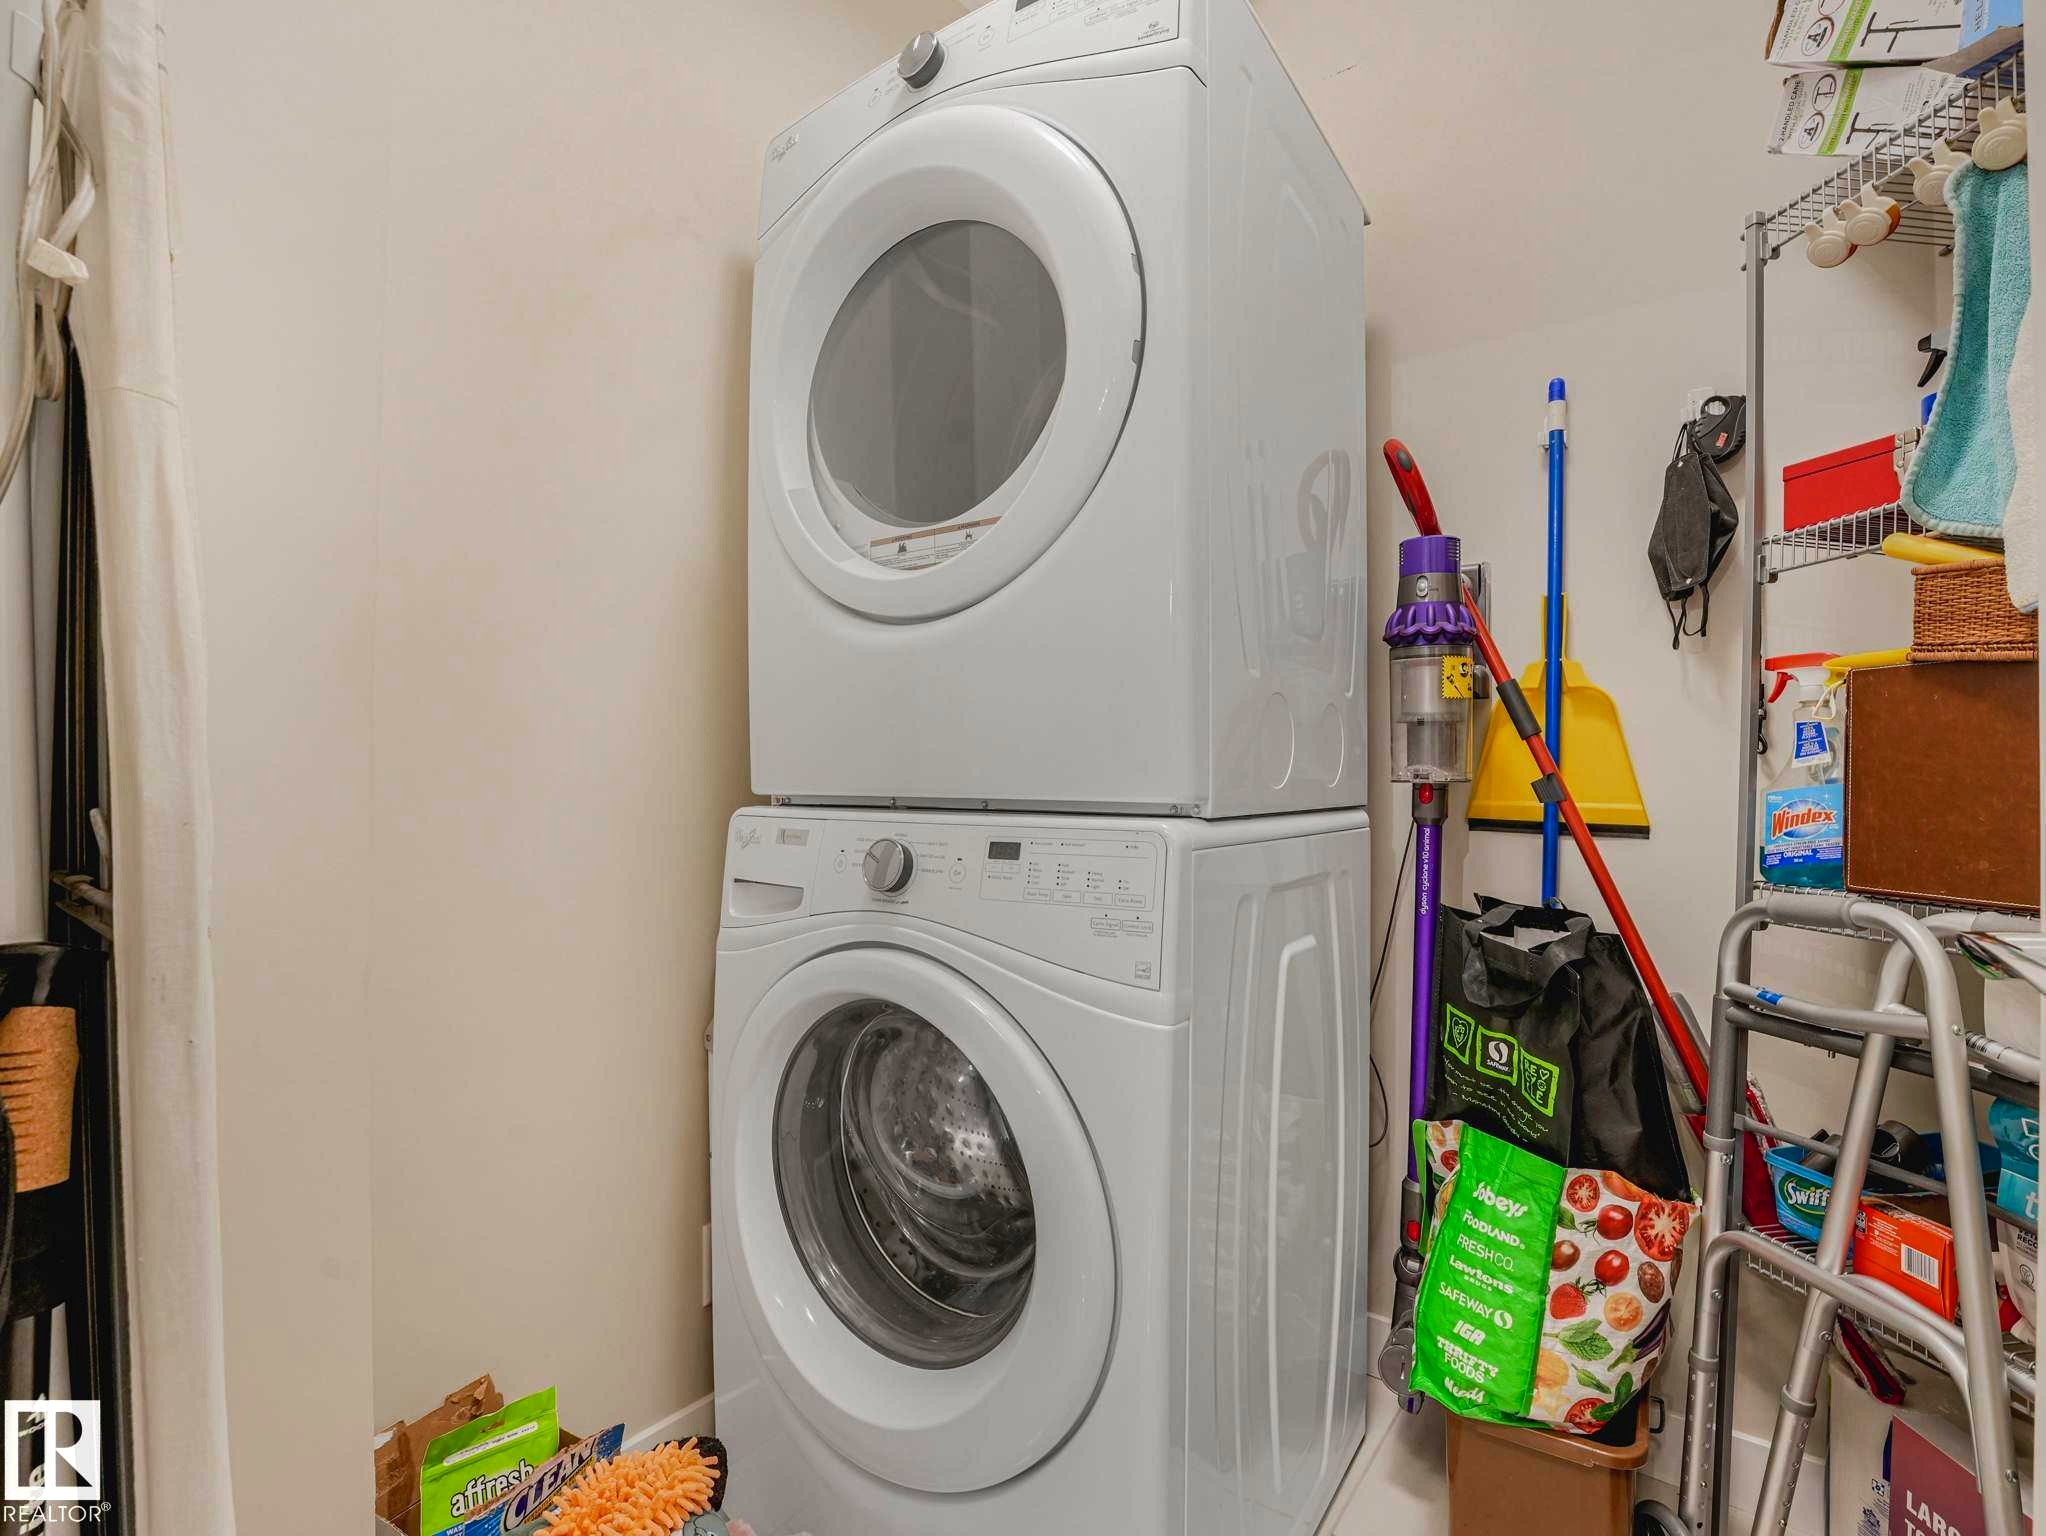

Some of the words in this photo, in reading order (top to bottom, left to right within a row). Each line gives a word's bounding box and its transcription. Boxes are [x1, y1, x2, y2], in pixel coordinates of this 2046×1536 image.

[1791, 79, 1801, 100] CANE
[1772, 807, 1835, 839] Windex
[1423, 827, 1431, 851] animal
[1783, 849, 1813, 858] ORIGINAL
[1421, 864, 1430, 890] cyclone
[1419, 892, 1429, 915] dyson
[1788, 1182, 1831, 1206] Swiff
[1463, 1211, 1521, 1247] FOODLAND
[2017, 1233, 2038, 1248] RECO
[1449, 1254, 1514, 1294] Lawtons
[1439, 1282, 1494, 1319] SAFEWAY
[1453, 1319, 1486, 1346] IGA
[1437, 1335, 1498, 1377] THRIFTY
[1444, 1352, 1485, 1383] FOODS
[451, 1458, 534, 1518] affresh
